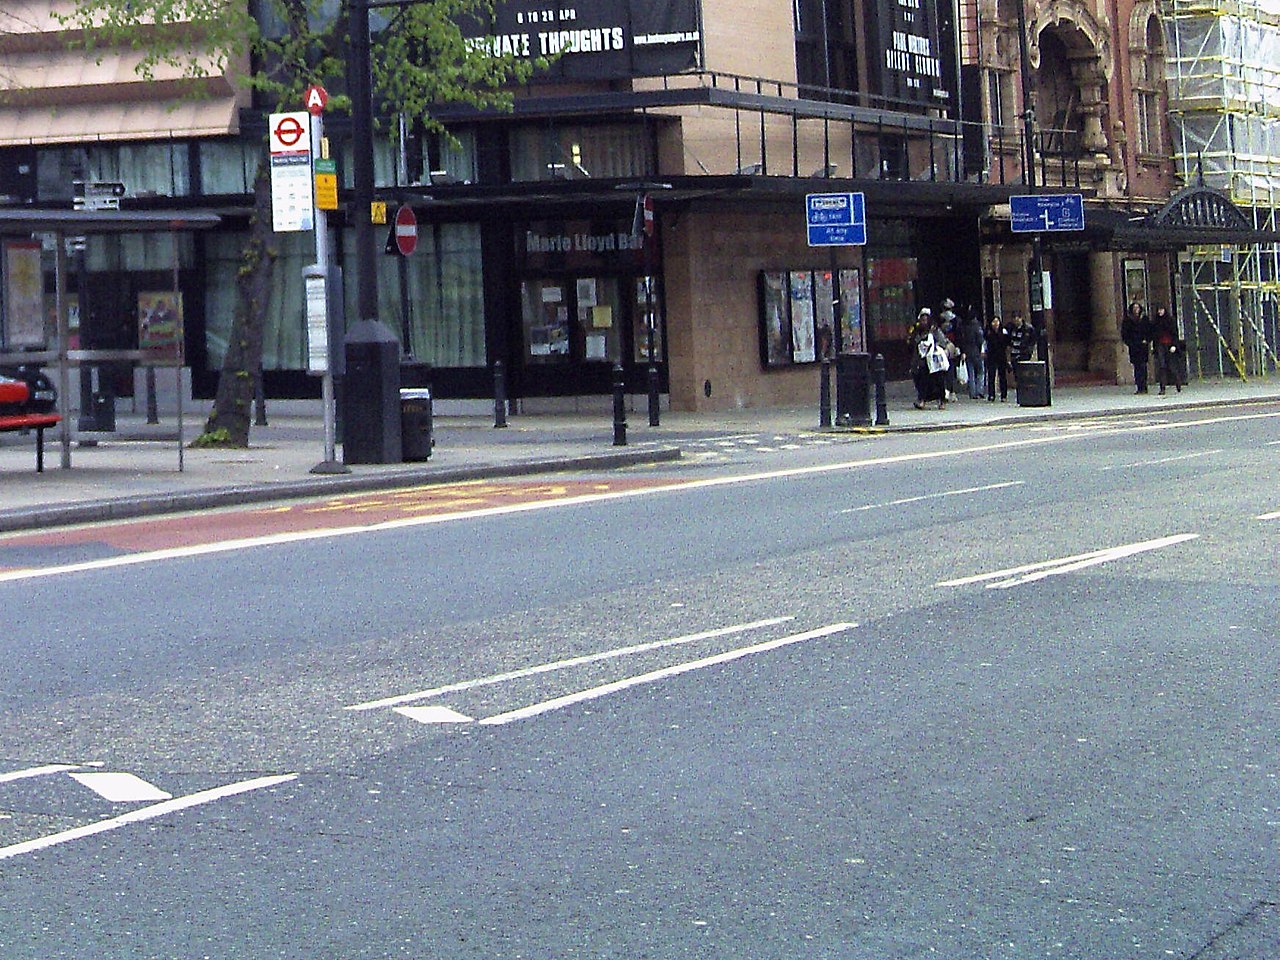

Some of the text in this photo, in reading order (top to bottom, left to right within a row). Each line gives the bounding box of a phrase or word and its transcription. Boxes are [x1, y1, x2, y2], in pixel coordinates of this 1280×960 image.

[527, 11, 539, 23] TO
[538, 27, 624, 55] THOUGHTS
[308, 88, 323, 108] A
[575, 233, 615, 252] Lloyd
